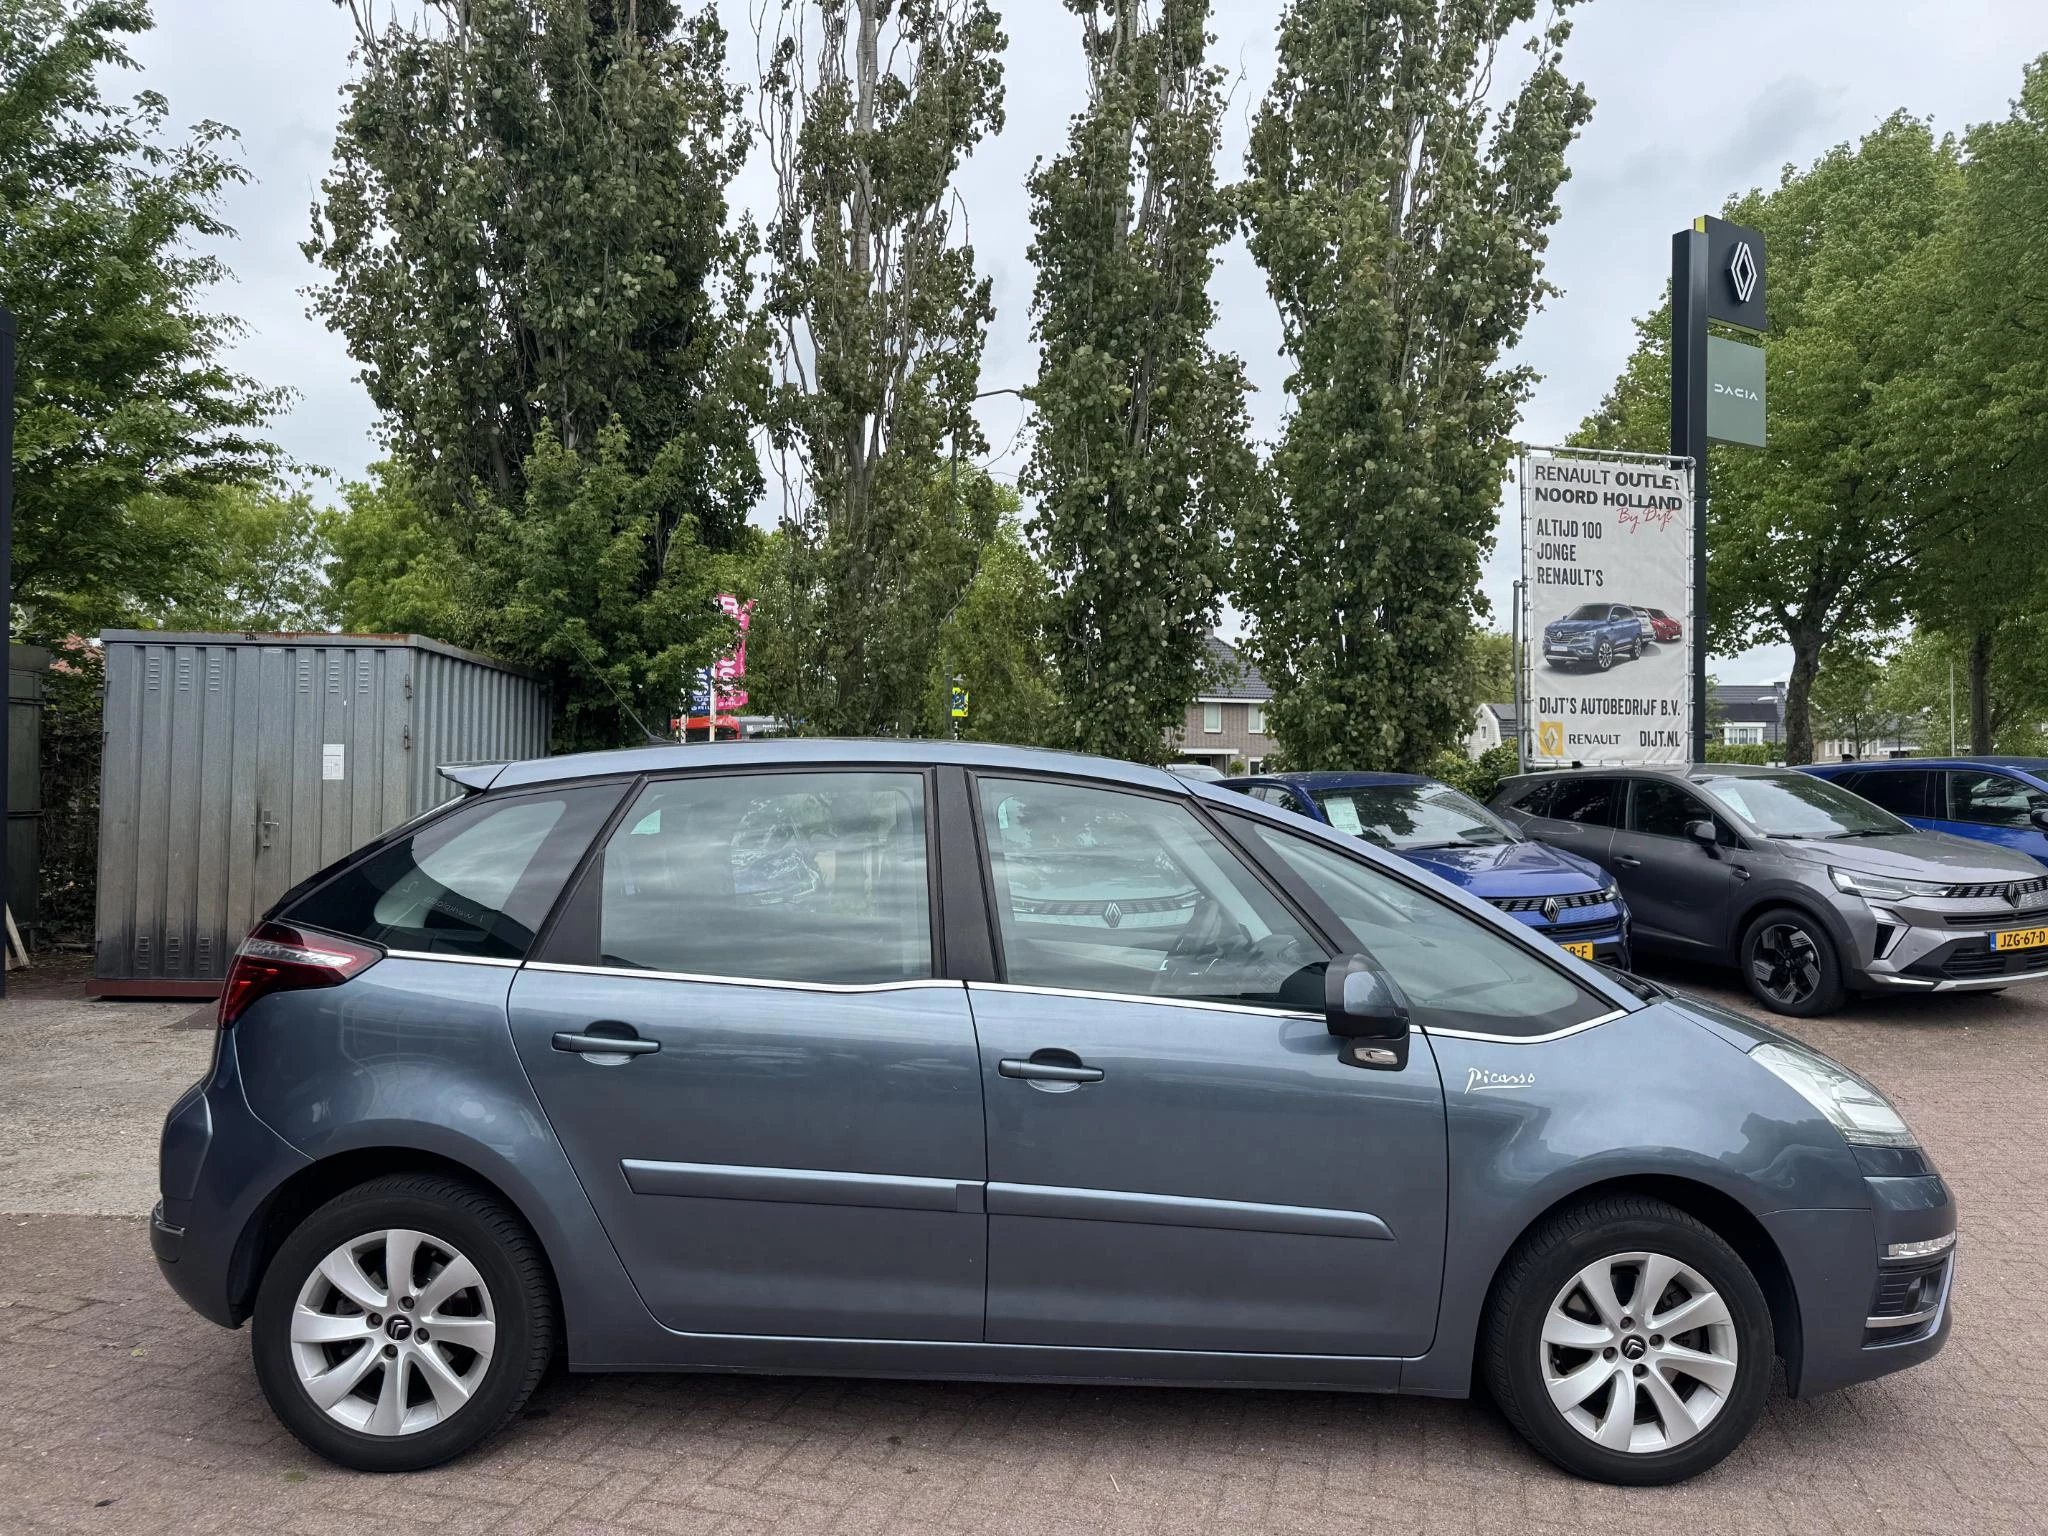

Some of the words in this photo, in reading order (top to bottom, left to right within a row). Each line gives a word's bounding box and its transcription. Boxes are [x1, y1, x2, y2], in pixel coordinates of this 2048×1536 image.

[1714, 383, 1758, 401] DACIA
[1535, 465, 1610, 485] RENAULT
[1615, 471, 1679, 490] OUTLET
[1535, 487, 1598, 505] NOORD
[1603, 492, 1683, 510] HOLLAND
[1536, 518, 1579, 537] ALTIJD
[1582, 521, 1602, 539] 100
[1617, 507, 1640, 534] By
[1536, 543, 1577, 561] JONGE
[1537, 566, 1604, 587] RENAULT'S
[1539, 697, 1577, 715] DIJT'S
[1580, 697, 1657, 716] AUTOBEDRIJF
[1661, 700, 1681, 716] B.V.
[1568, 734, 1621, 745] RENAULT
[1639, 730, 1680, 747] DIJT.NL
[2000, 930, 2046, 948] JZG-67-D
[1464, 1067, 1536, 1094] Picasso
